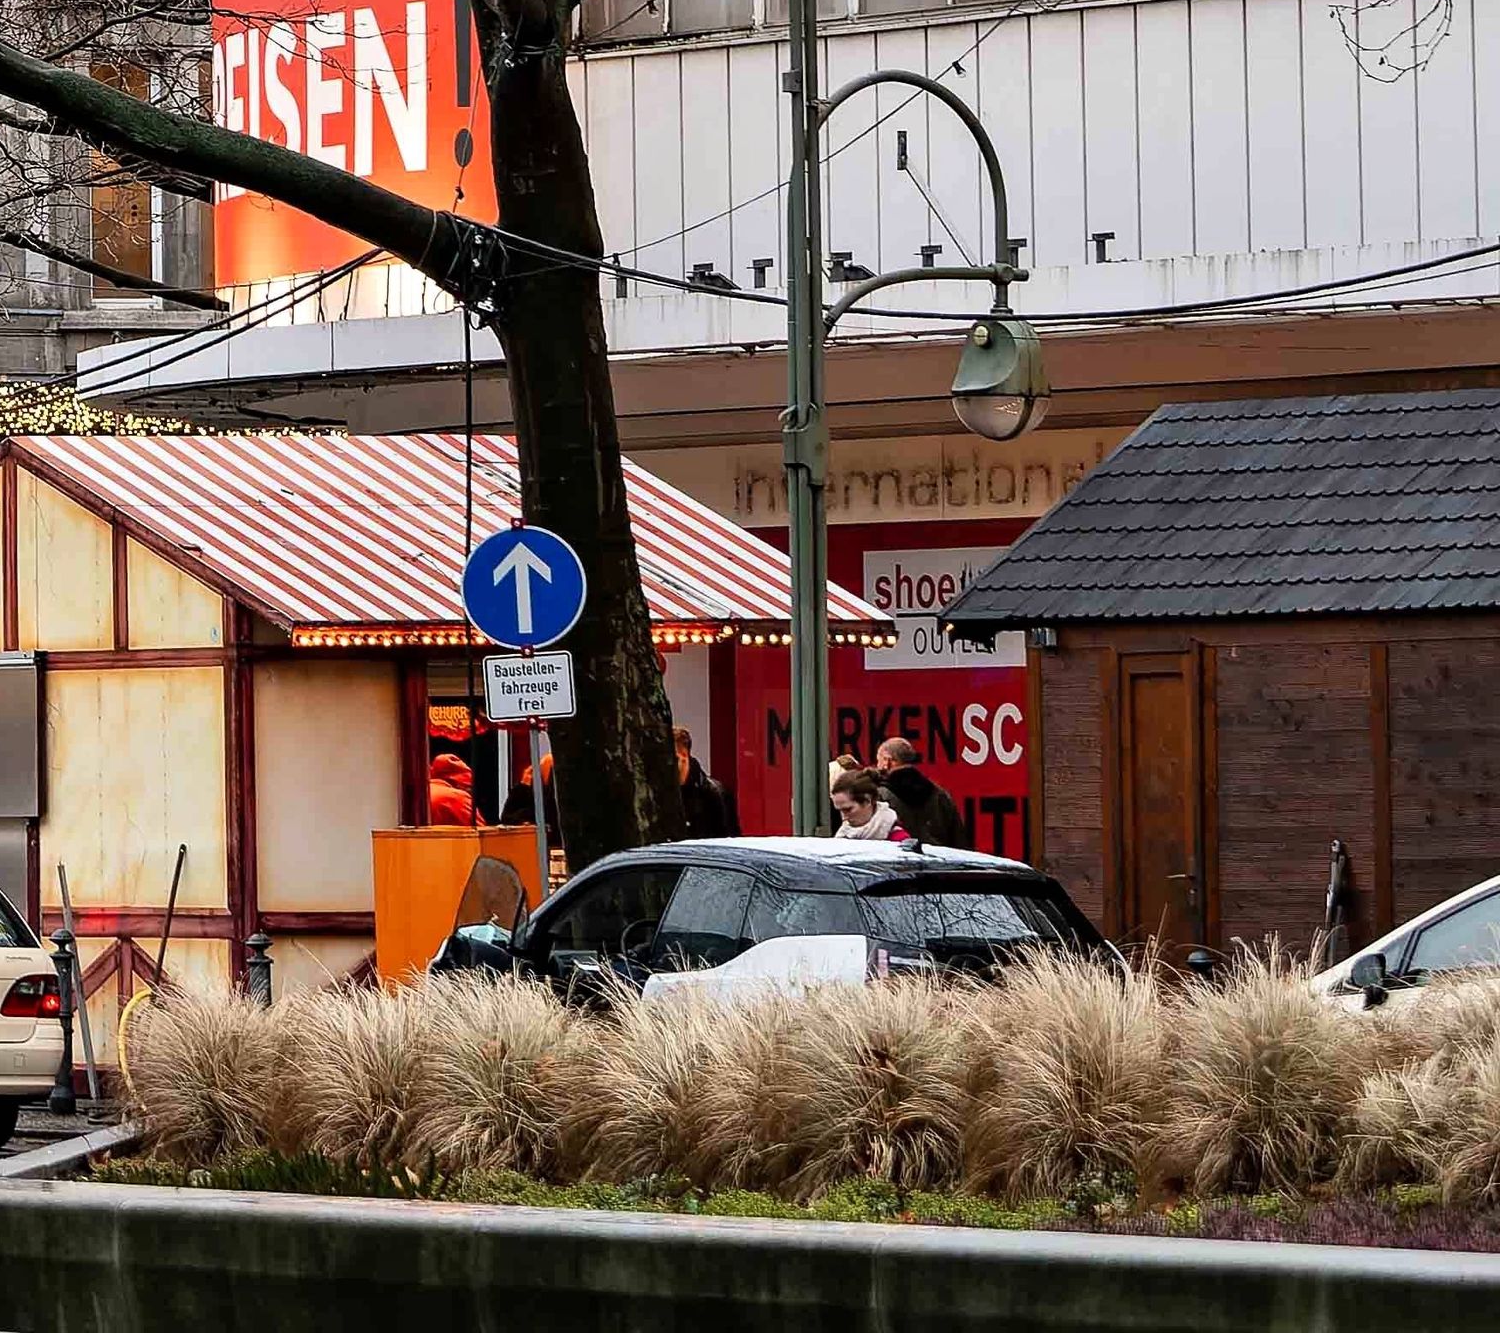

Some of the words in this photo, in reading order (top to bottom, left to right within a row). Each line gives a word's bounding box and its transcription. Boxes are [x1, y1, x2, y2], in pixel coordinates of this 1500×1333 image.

[494, 662, 562, 678] Baustellen-
[501, 680, 559, 696] fahrzeuge
[518, 696, 545, 711] frei
[766, 701, 1024, 767] MRKENSC
